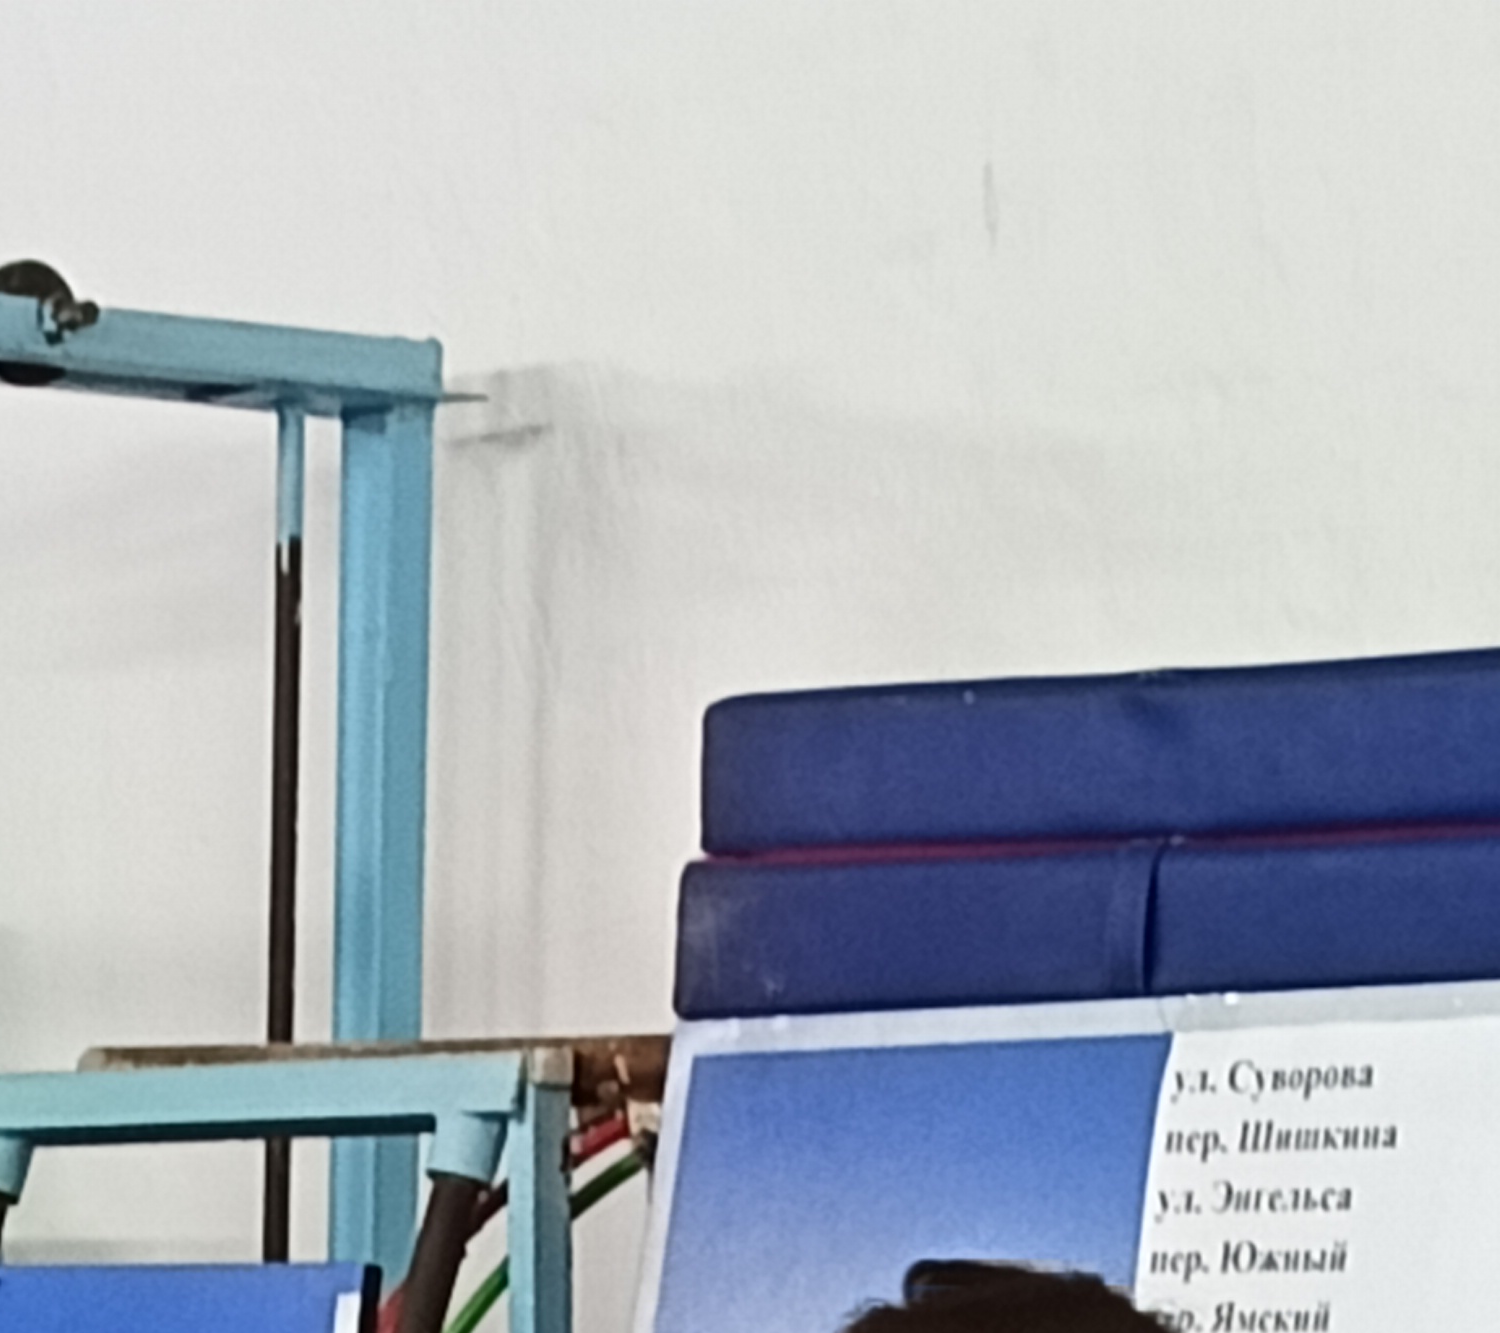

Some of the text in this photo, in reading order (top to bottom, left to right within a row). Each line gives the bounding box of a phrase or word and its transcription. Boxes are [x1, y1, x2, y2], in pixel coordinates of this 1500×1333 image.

[1170, 1059, 1375, 1103] ул. Суворова
[1164, 1120, 1399, 1163] пер. Шишкина
[1154, 1180, 1353, 1224] ул. Энгельса
[1149, 1240, 1348, 1283] пер. Южный
[1210, 1300, 1331, 1333] Ямский
